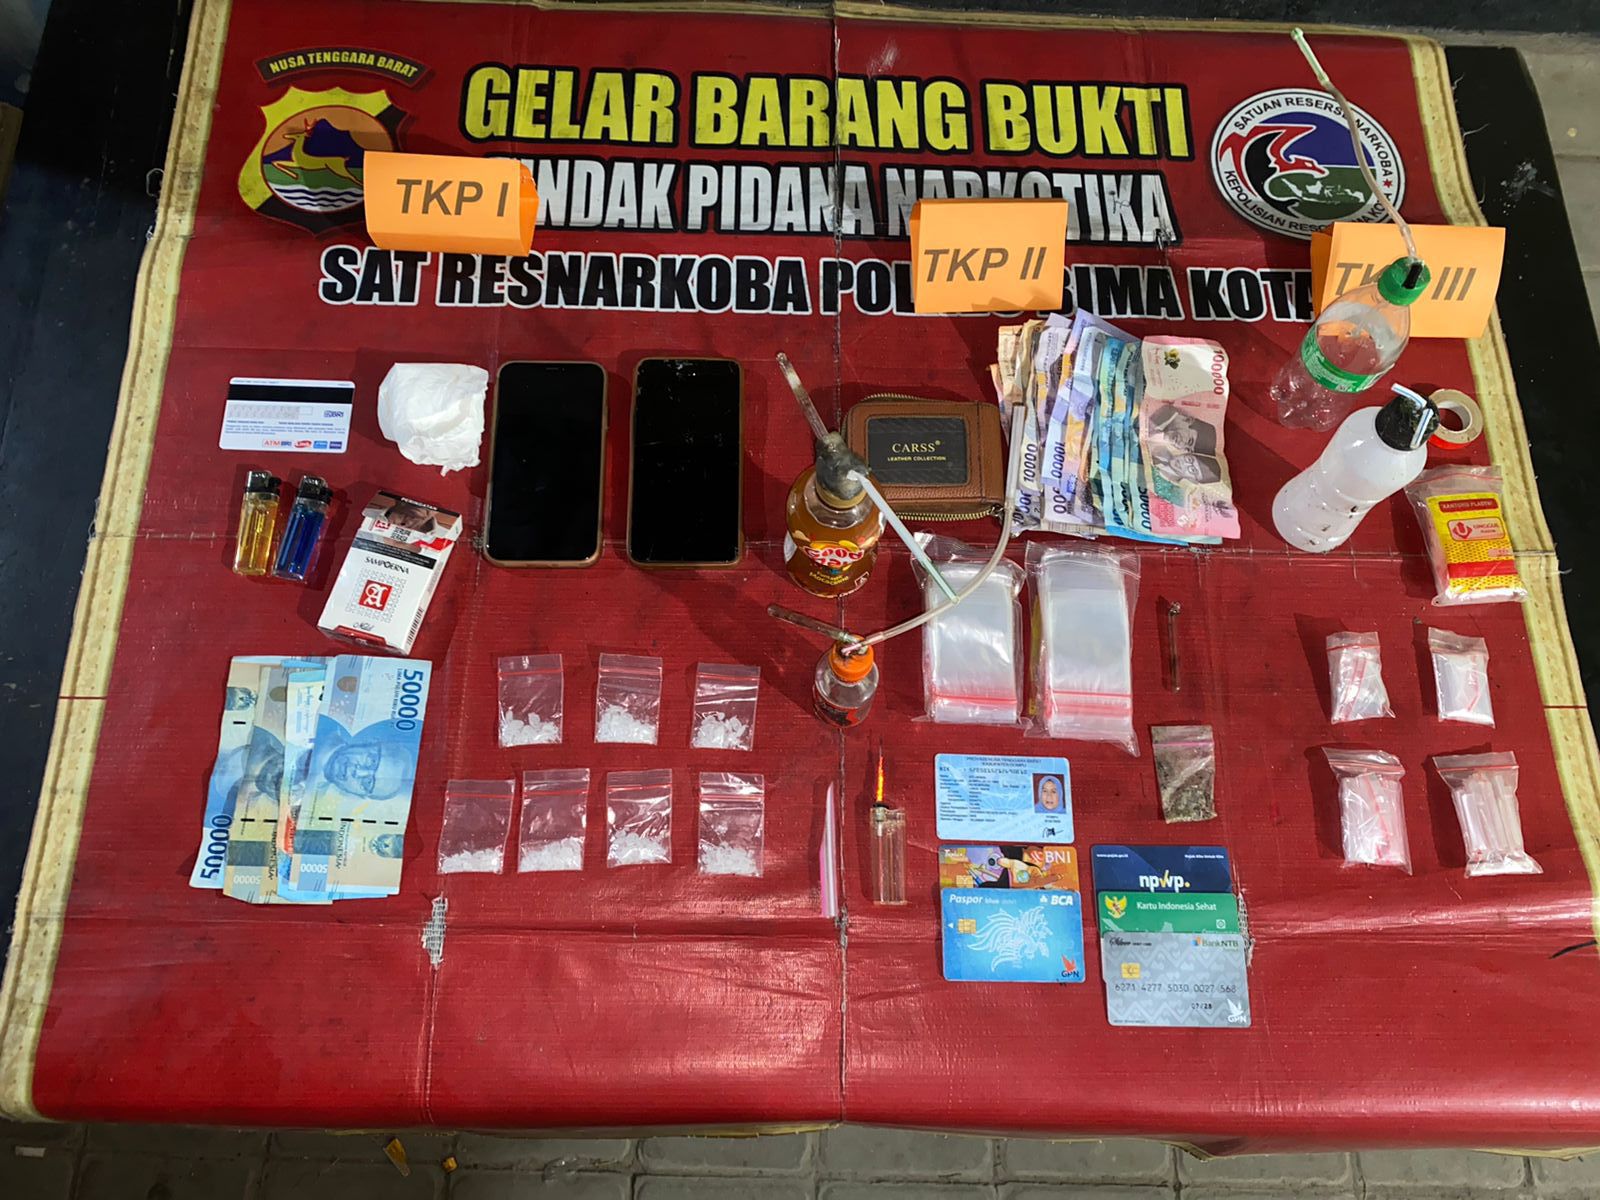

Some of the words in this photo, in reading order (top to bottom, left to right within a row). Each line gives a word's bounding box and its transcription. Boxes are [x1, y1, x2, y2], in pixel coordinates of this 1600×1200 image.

[269, 55, 306, 74] NUSA
[307, 51, 375, 66] TENGGARA
[376, 56, 419, 78] BARAT
[463, 65, 677, 145] GELAR
[693, 74, 969, 151] BARANG
[984, 82, 1190, 158] BUKTI
[1234, 98, 1283, 131] SATUAN
[1285, 96, 1347, 119] RESERS
[1355, 118, 1394, 178] NARKOBA
[396, 178, 483, 217] TKP
[496, 182, 509, 217] I
[518, 158, 677, 230] NDAK
[687, 162, 876, 236] PIDANA
[1224, 170, 1287, 228] KEPOLISIAN
[319, 245, 431, 305] SAT
[435, 249, 813, 313] RESNARKOBA
[924, 247, 1009, 283] TKP
[1020, 246, 1047, 281] II
[1431, 266, 1478, 302] III
[1211, 349, 1226, 396] 100000
[1023, 443, 1038, 483] 10000
[363, 556, 410, 575] SAMPOERNA
[395, 668, 424, 731] 50000
[200, 814, 233, 880] 50000
[335, 821, 346, 870] INDONESIA
[1044, 850, 1071, 864] BNI
[300, 863, 328, 874] 50000
[949, 894, 983, 906] Paspor
[1050, 895, 1074, 906] BCA
[1136, 901, 1157, 911] Kartu
[1157, 901, 1195, 911] Indonesia
[1195, 902, 1217, 911] Sehat
[1060, 970, 1080, 978] GPN
[1114, 983, 1136, 992] 6271
[1141, 983, 1162, 992] 4277
[1193, 984, 1215, 993] 0027
[1227, 1015, 1247, 1024] GPN
